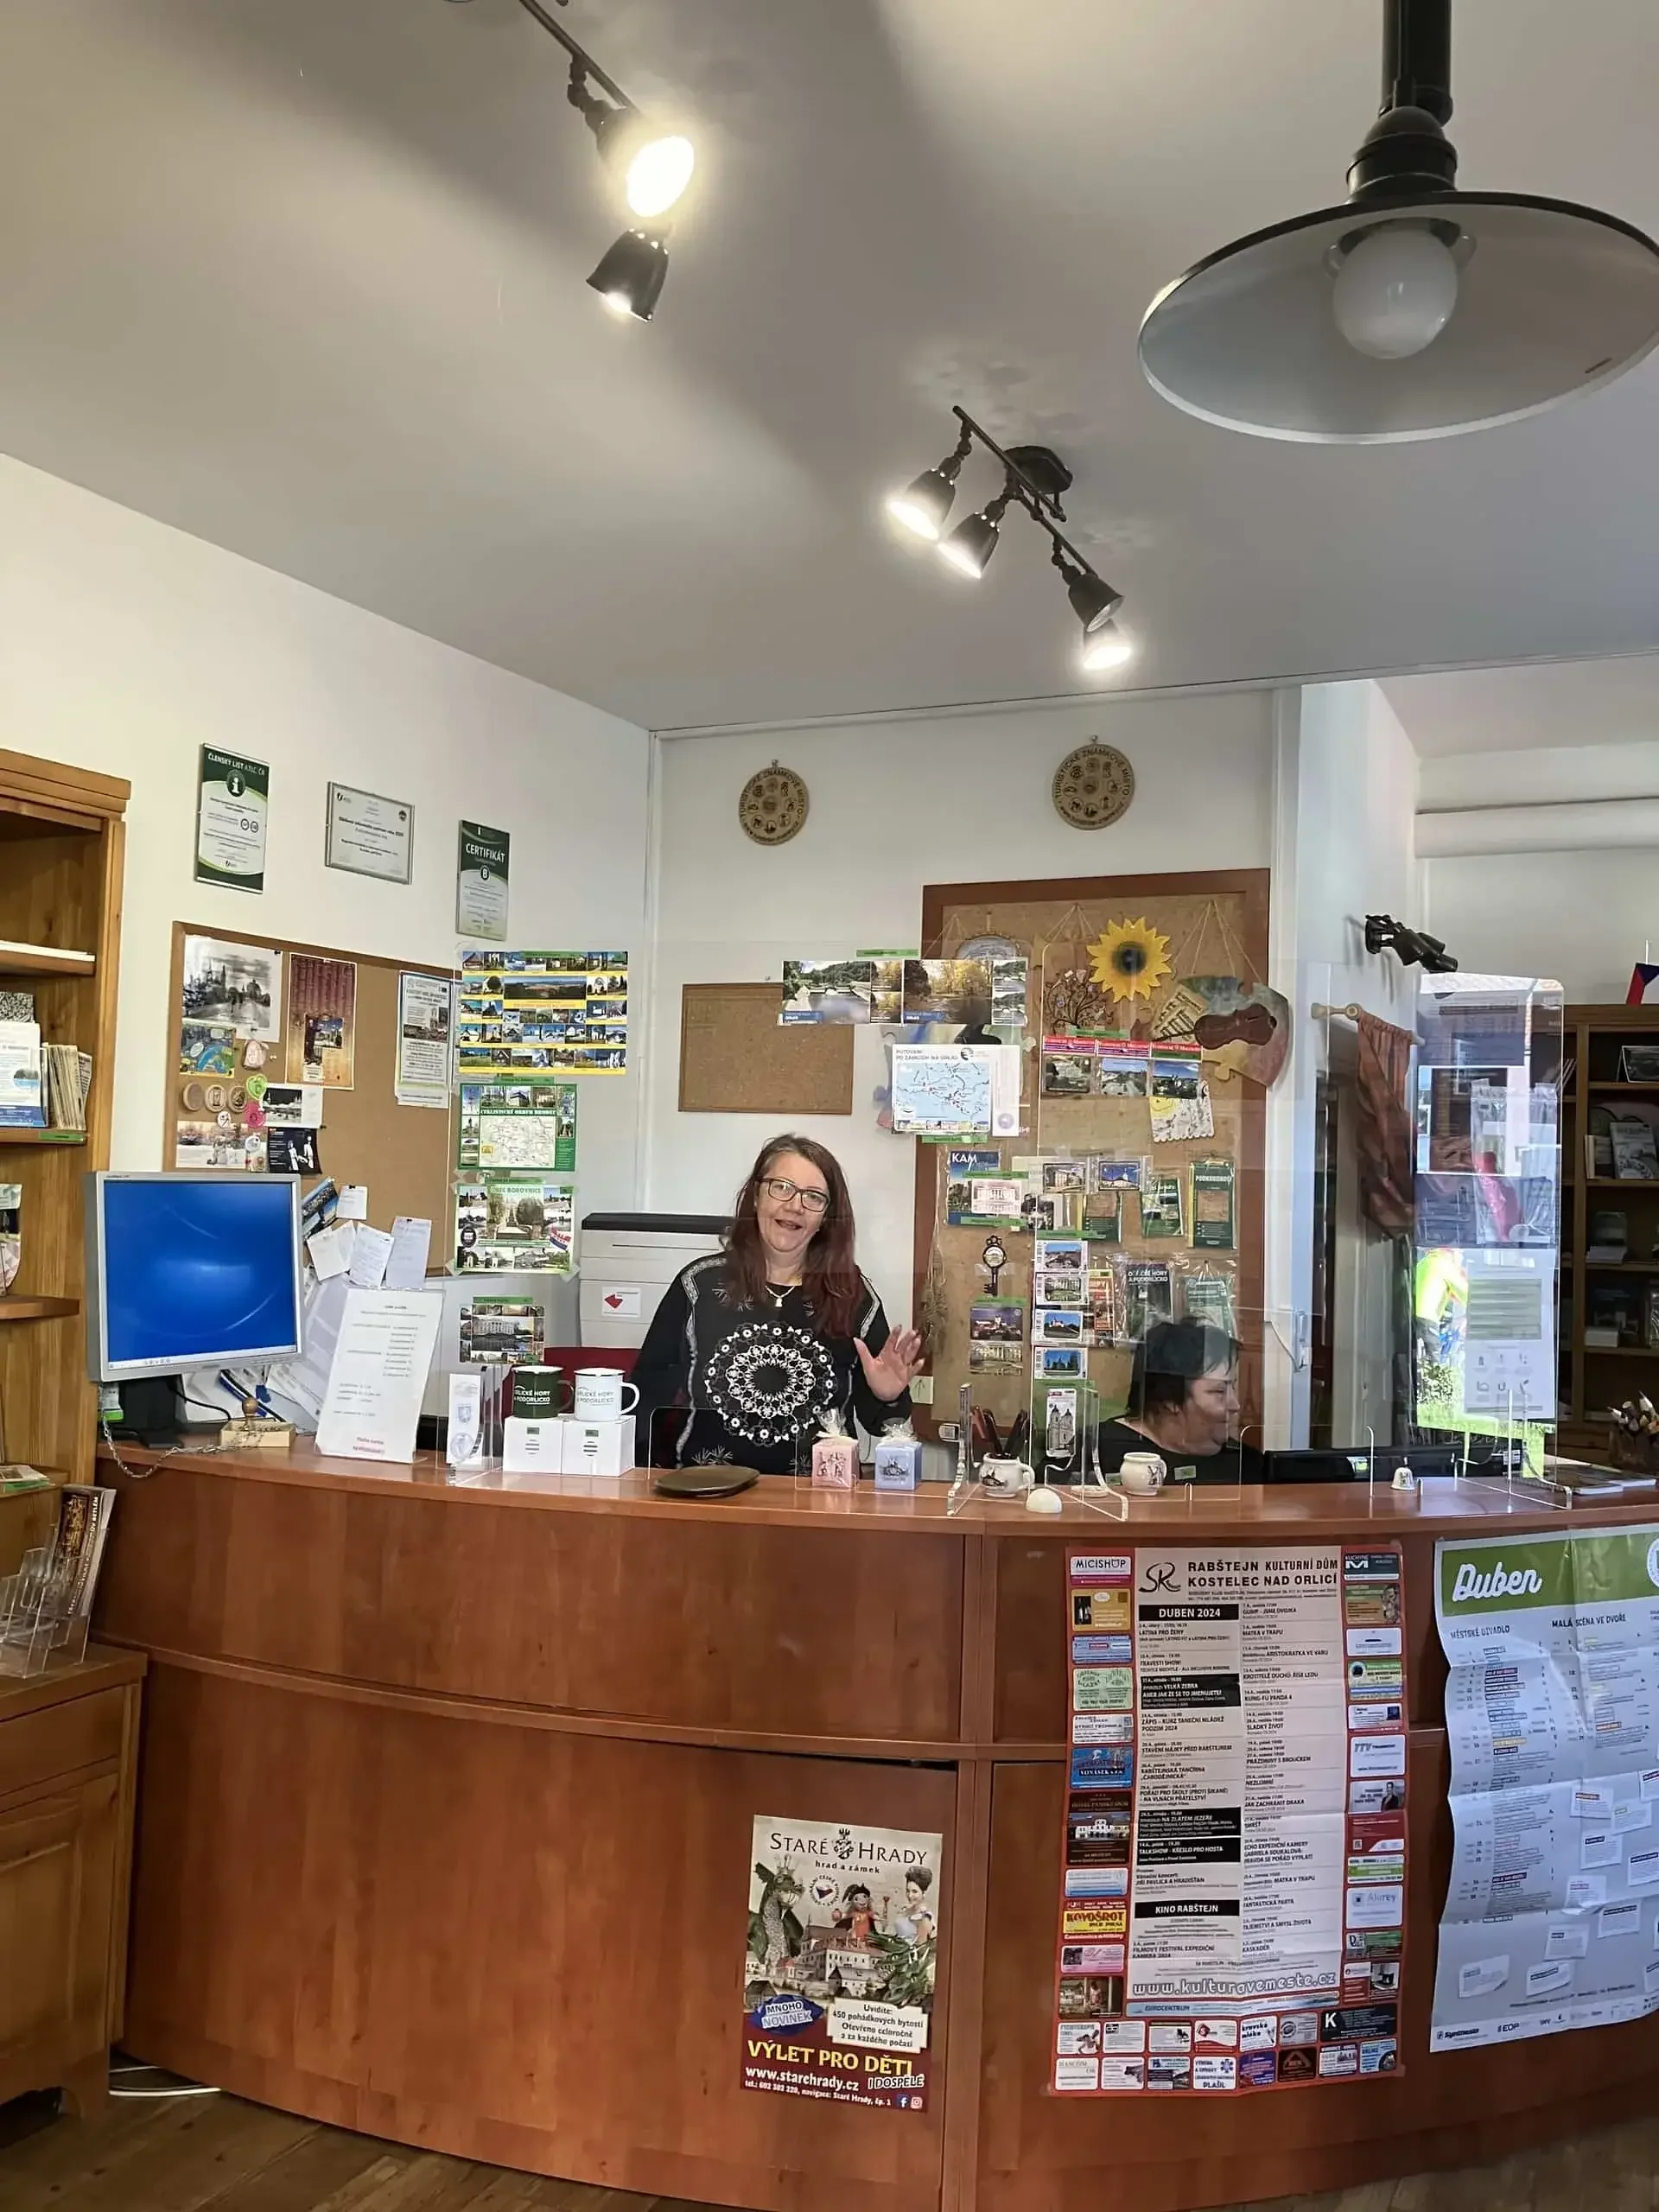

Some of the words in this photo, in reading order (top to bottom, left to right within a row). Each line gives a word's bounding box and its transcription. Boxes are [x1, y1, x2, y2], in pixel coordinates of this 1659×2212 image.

[208, 753, 231, 767] ČLENSKÝ
[232, 760, 244, 770] LIST
[466, 842, 505, 863] CERTIFIKÁT
[952, 1153, 977, 1166] KAM
[1188, 1559, 1259, 1572] RABŠTEJN
[1265, 1558, 1313, 1571] KULTURNÍ
[1316, 1557, 1338, 1570] DŮM
[1188, 1576, 1259, 1587] KOSTELEC
[1264, 1575, 1290, 1586] NAD
[1295, 1573, 1337, 1586] ORLICÍ
[1452, 1561, 1543, 1602] Duben
[1159, 1608, 1195, 1618] DUBEN
[1197, 1607, 1221, 1618] 2024
[1552, 1617, 1573, 1628] MALÁ
[1575, 1616, 1595, 1627] SCÉNA
[1596, 1615, 1605, 1625] VE
[1605, 1613, 1626, 1625] DVOŘE
[1450, 1627, 1480, 1639] MĚSTSKÉ
[1481, 1624, 1510, 1637] DIVADLO
[770, 1832, 829, 1855] STARÉ
[859, 1841, 927, 1866] HRADY
[815, 1859, 837, 1869] hrad
[849, 1864, 880, 1874] zámek
[1066, 1910, 1124, 1923] KOVOŠROT
[1155, 1905, 1176, 1914] KINO
[1177, 1904, 1218, 1913] RABŠTEJN
[766, 2001, 803, 2014] MNOHO
[864, 2004, 893, 2015] Uvidíte:
[763, 2011, 811, 2027] NOVINEK
[848, 2012, 896, 2026] pohádkových
[898, 2018, 924, 2029] bytostí
[1325, 2012, 1338, 2028] K
[842, 2022, 876, 2034] Otevřeno
[877, 2027, 913, 2038] celoročně
[857, 2034, 888, 2046] každého
[889, 2039, 913, 2050] počasí
[747, 2039, 815, 2064] VÝLET
[818, 2050, 859, 2070] PRO
[864, 2054, 912, 2076] DĚTI
[745, 2066, 860, 2092] www.starehrady.cz
[874, 2073, 925, 2089] DOSPĚLÉ
[833, 2092, 850, 2102] Staré
